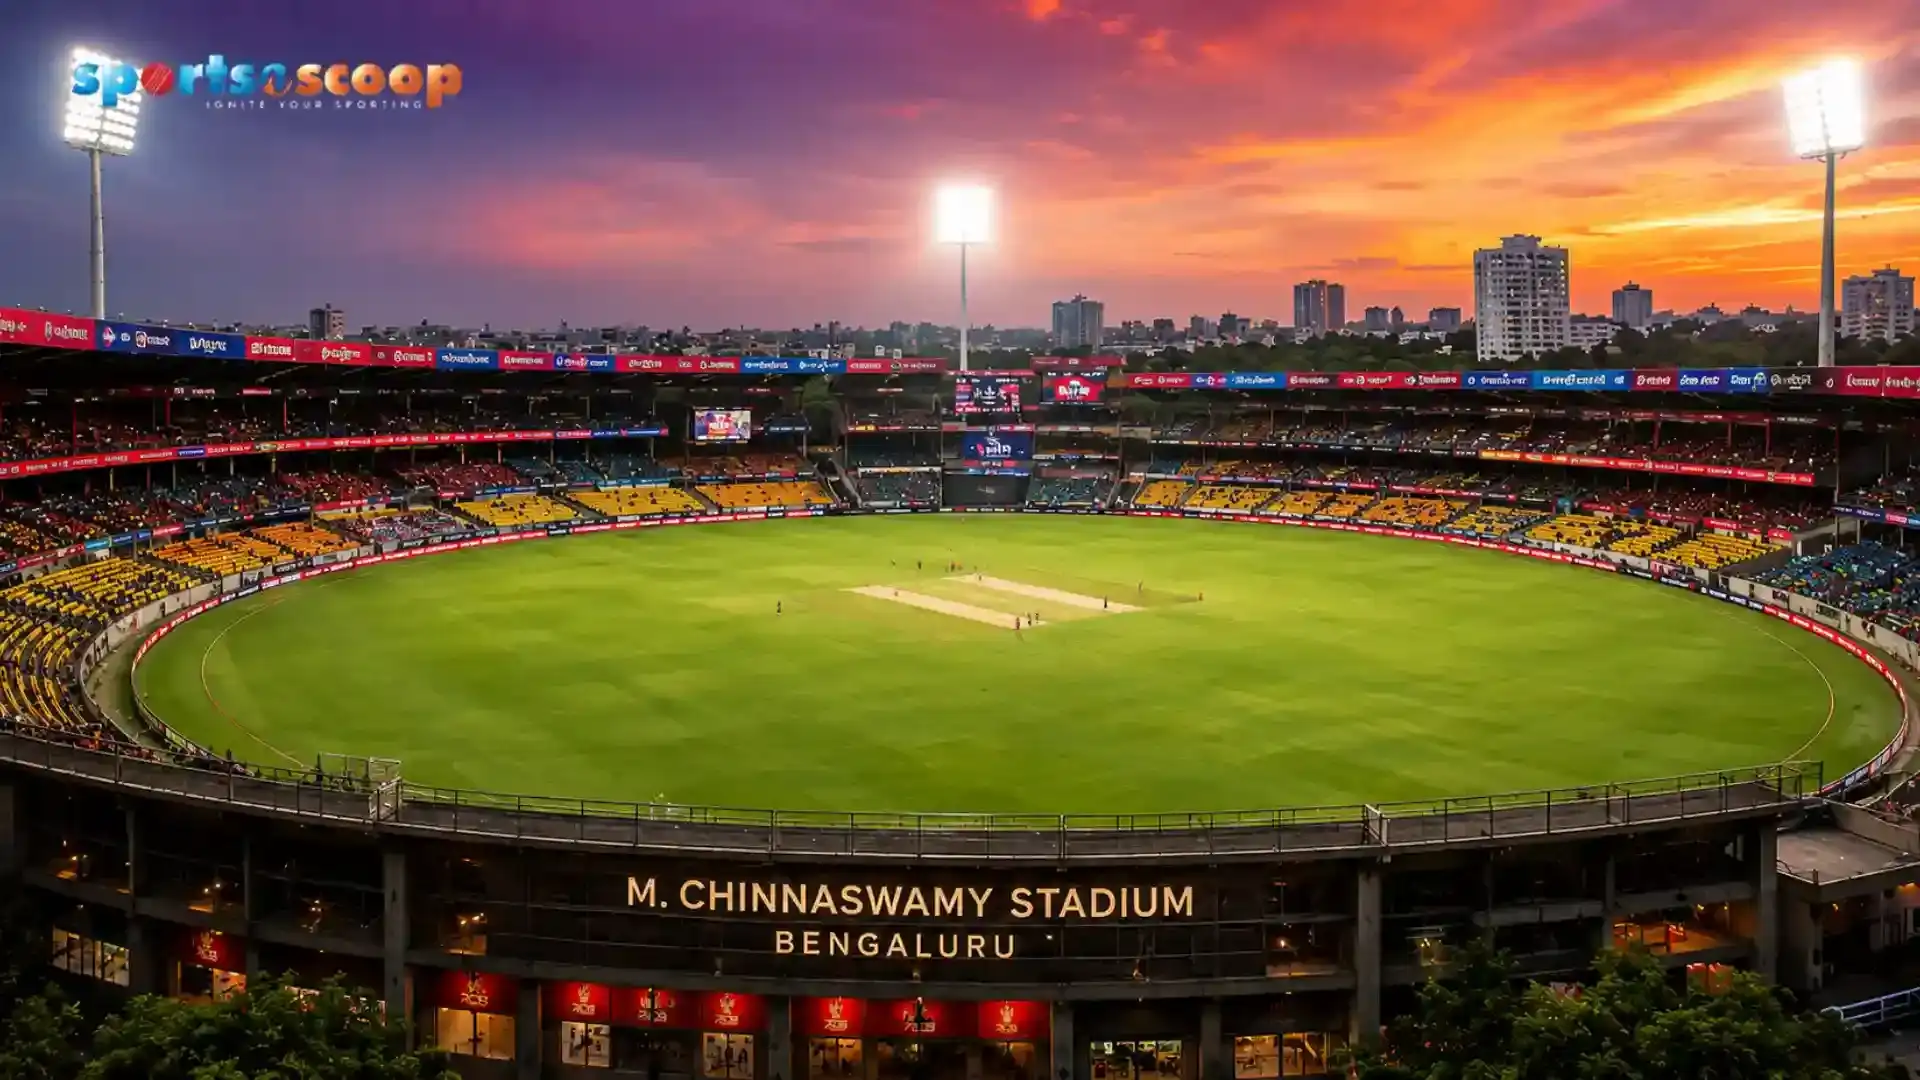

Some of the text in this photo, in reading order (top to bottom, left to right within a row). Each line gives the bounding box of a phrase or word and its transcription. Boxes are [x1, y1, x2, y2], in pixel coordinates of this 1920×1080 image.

[626, 876, 1194, 919] M. CHINNASWAMY STADIUM
[775, 930, 1016, 959] BENGALURU
